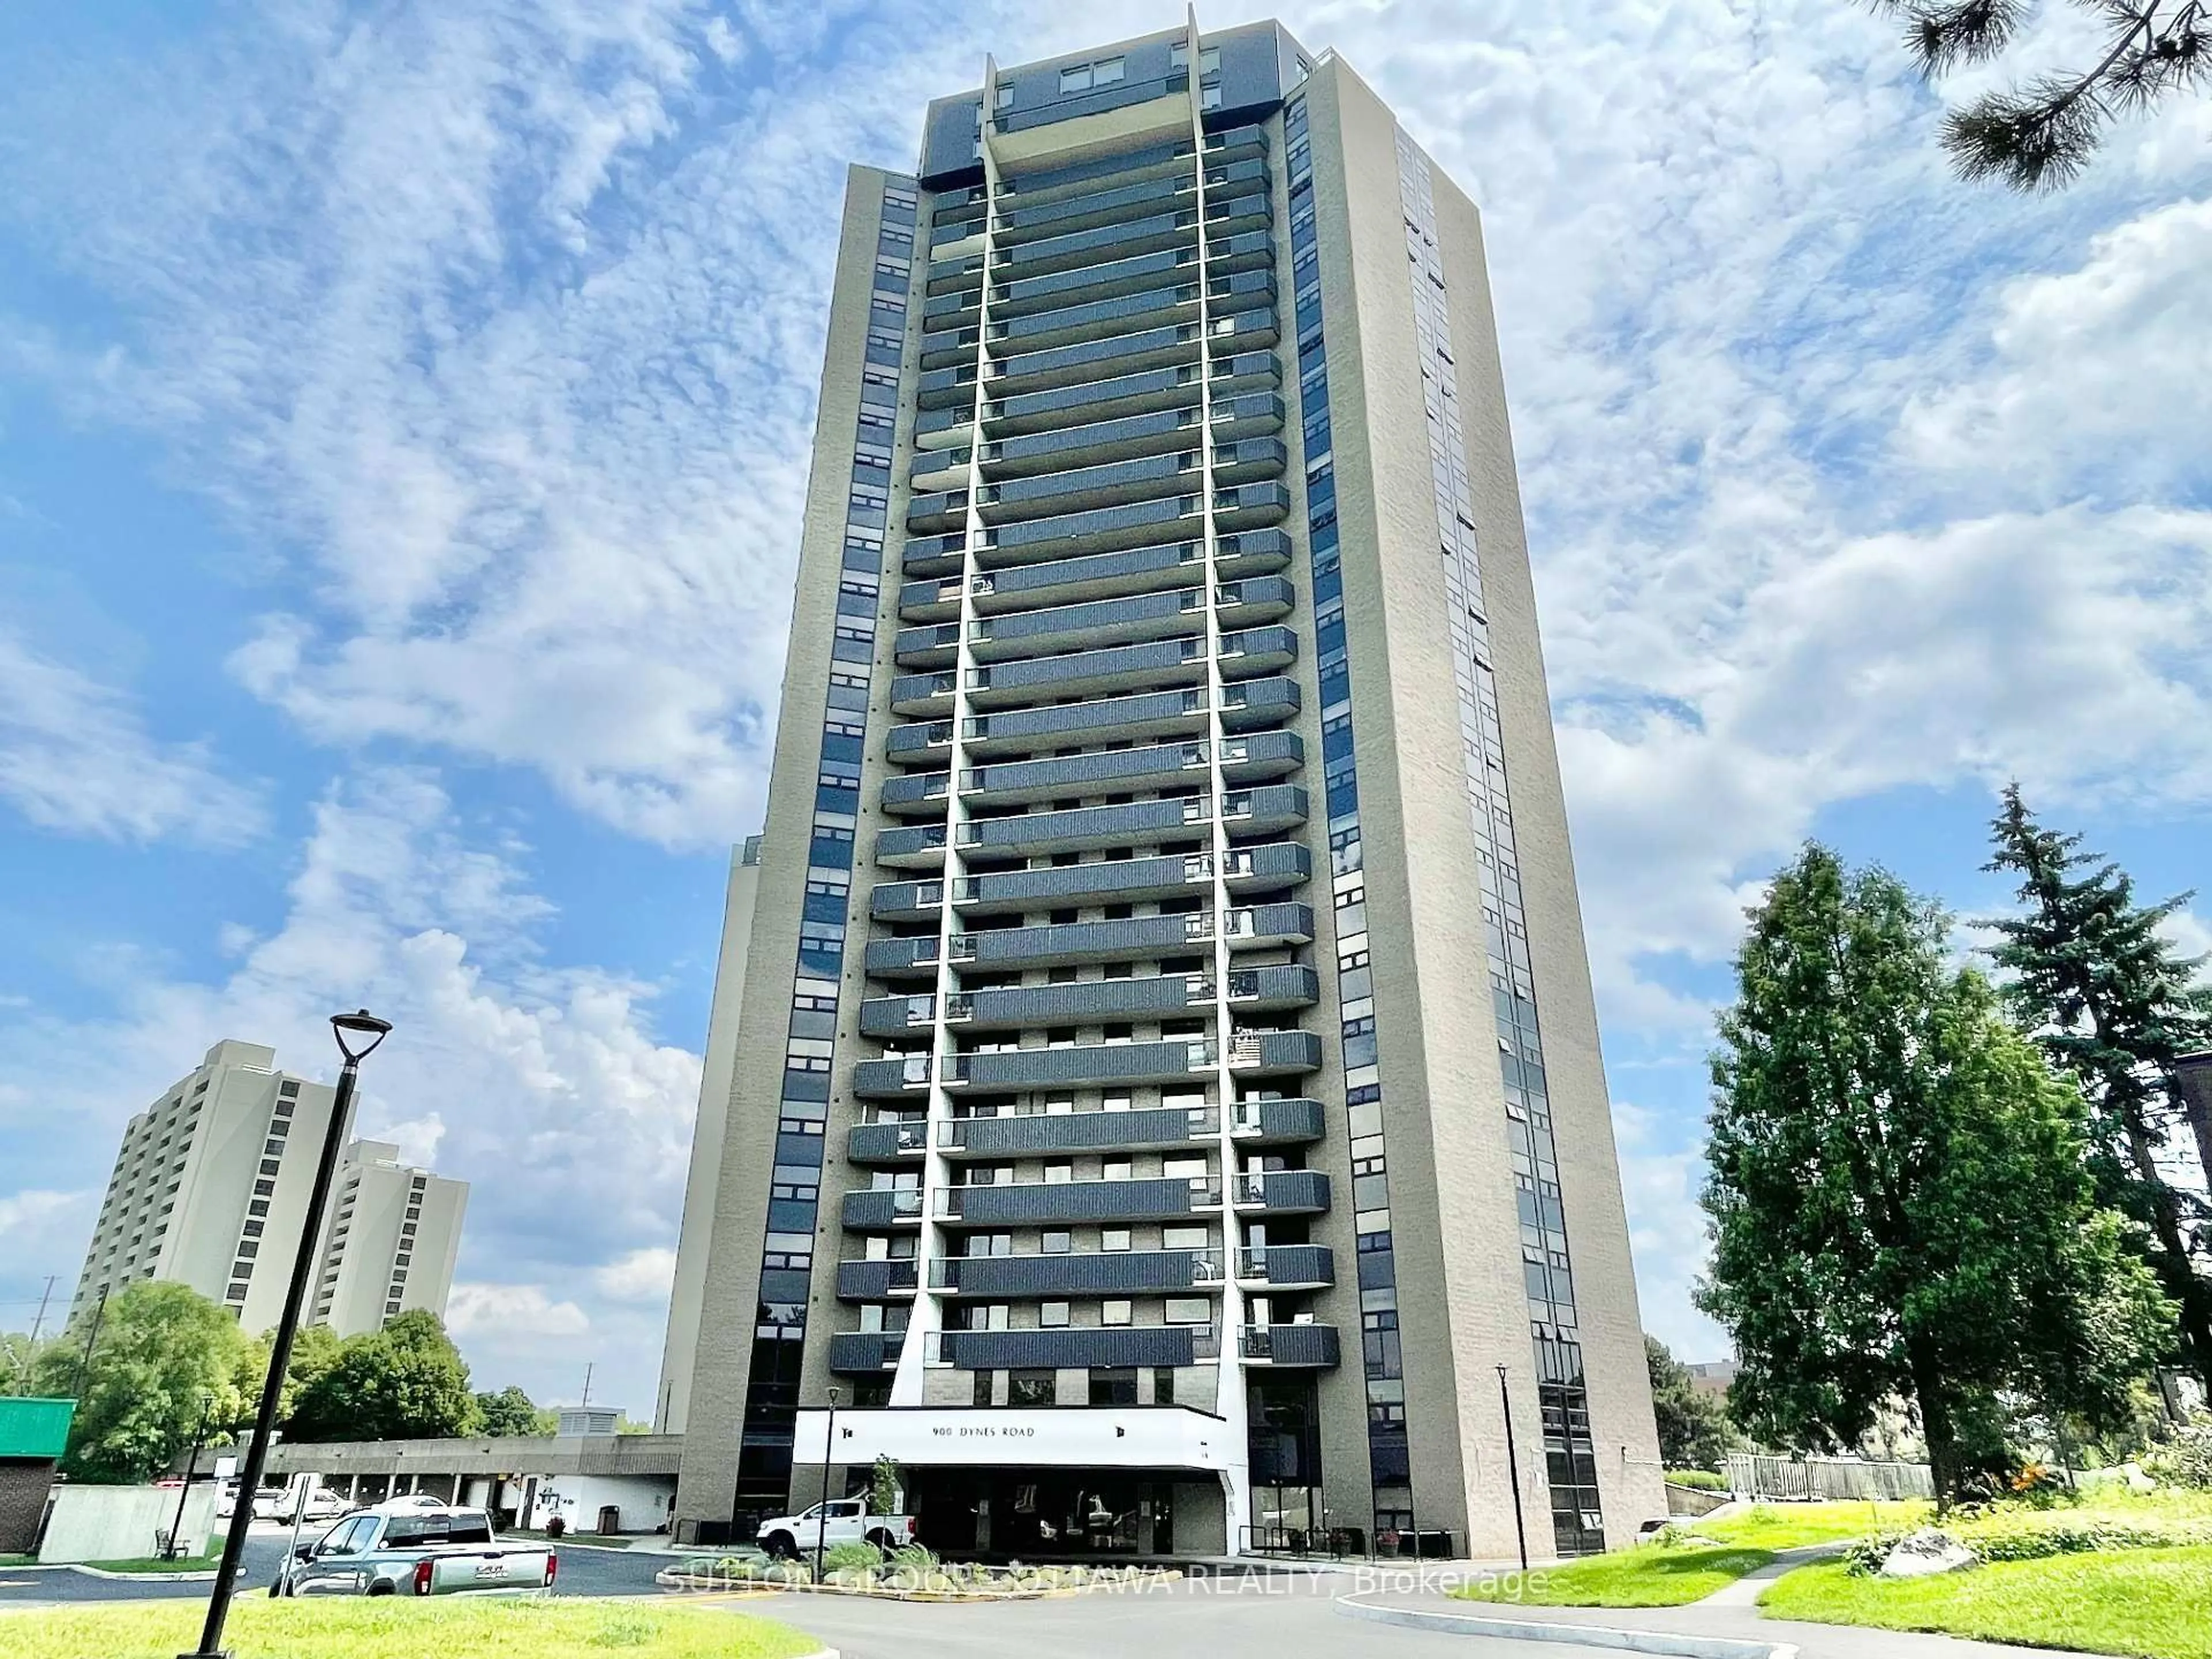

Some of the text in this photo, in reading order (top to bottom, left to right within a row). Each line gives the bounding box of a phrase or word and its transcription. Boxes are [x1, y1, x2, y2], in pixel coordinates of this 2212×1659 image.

[933, 1427, 1035, 1437] 900 DYNES ROAD
